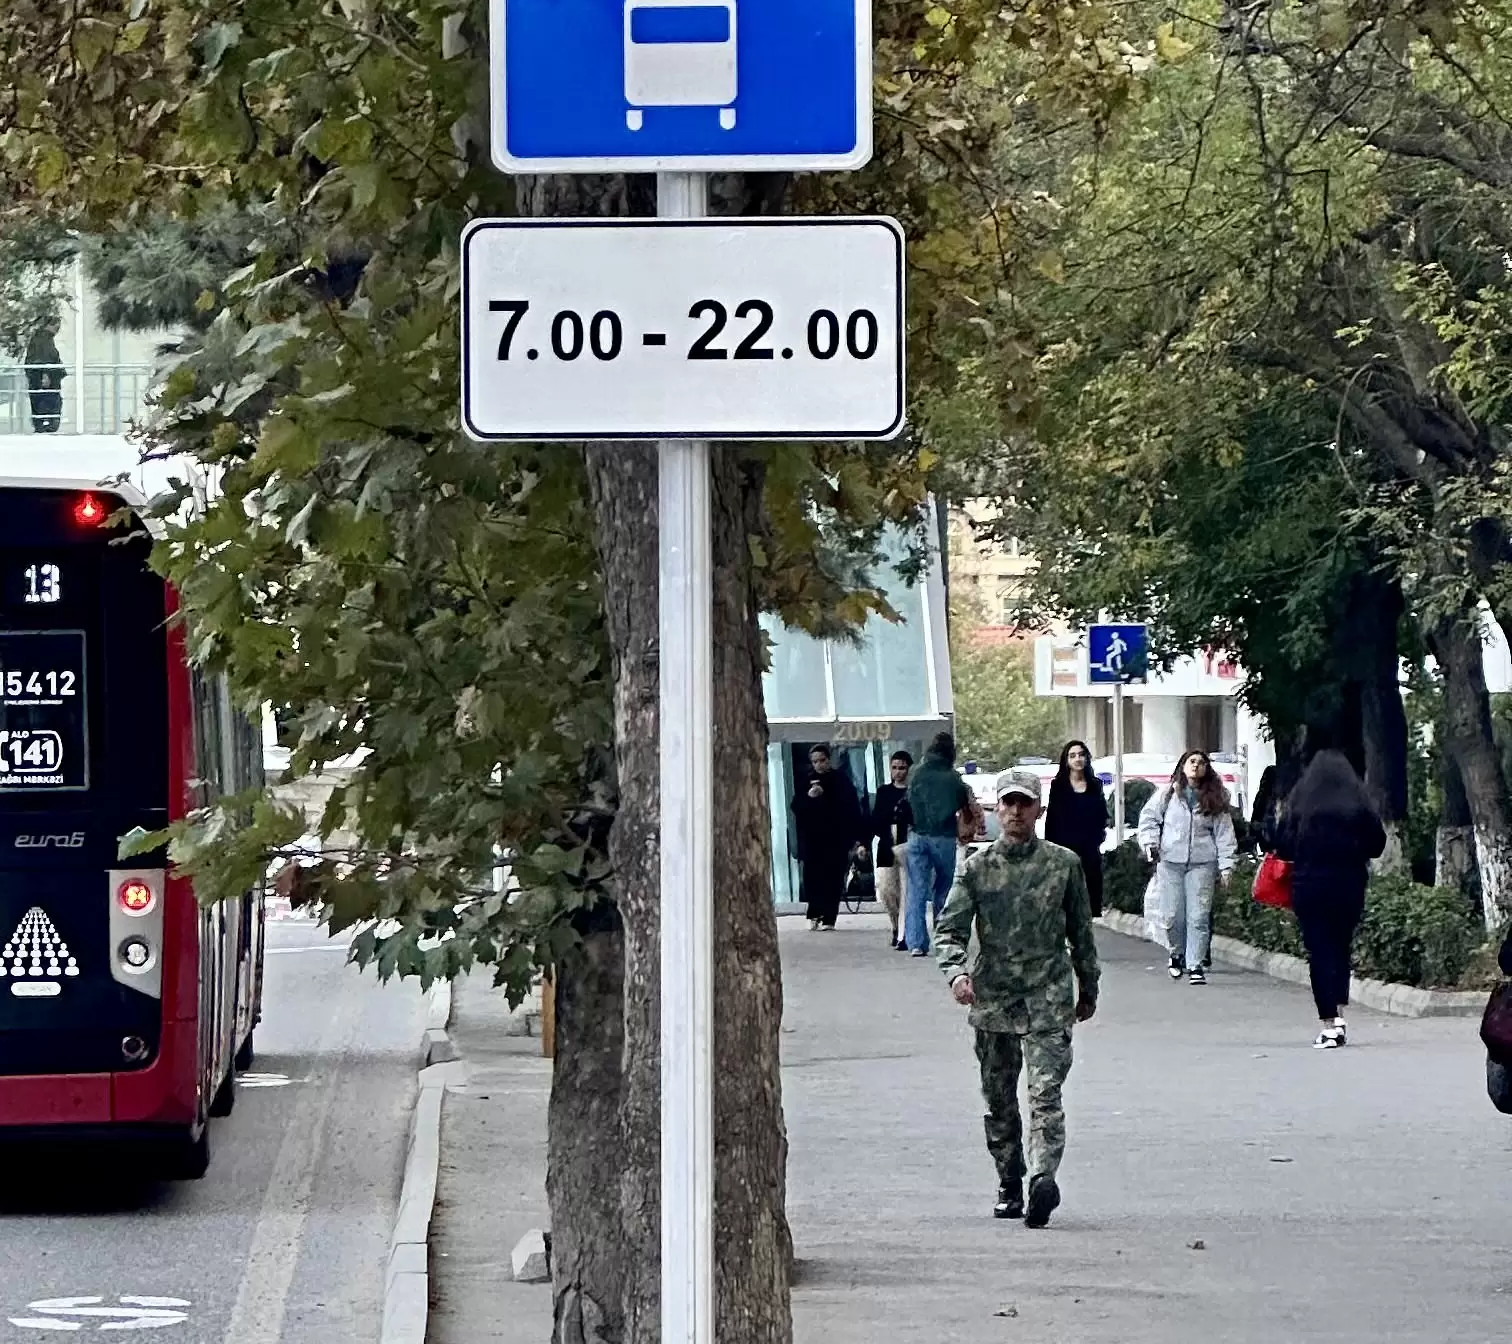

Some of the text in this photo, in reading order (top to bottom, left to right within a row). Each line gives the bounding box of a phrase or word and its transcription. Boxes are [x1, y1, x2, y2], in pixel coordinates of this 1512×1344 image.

[489, 299, 879, 361] 7.00 - 22.00
[25, 564, 60, 602] 13
[9, 739, 55, 766] 141
[14, 831, 85, 848] euro6
